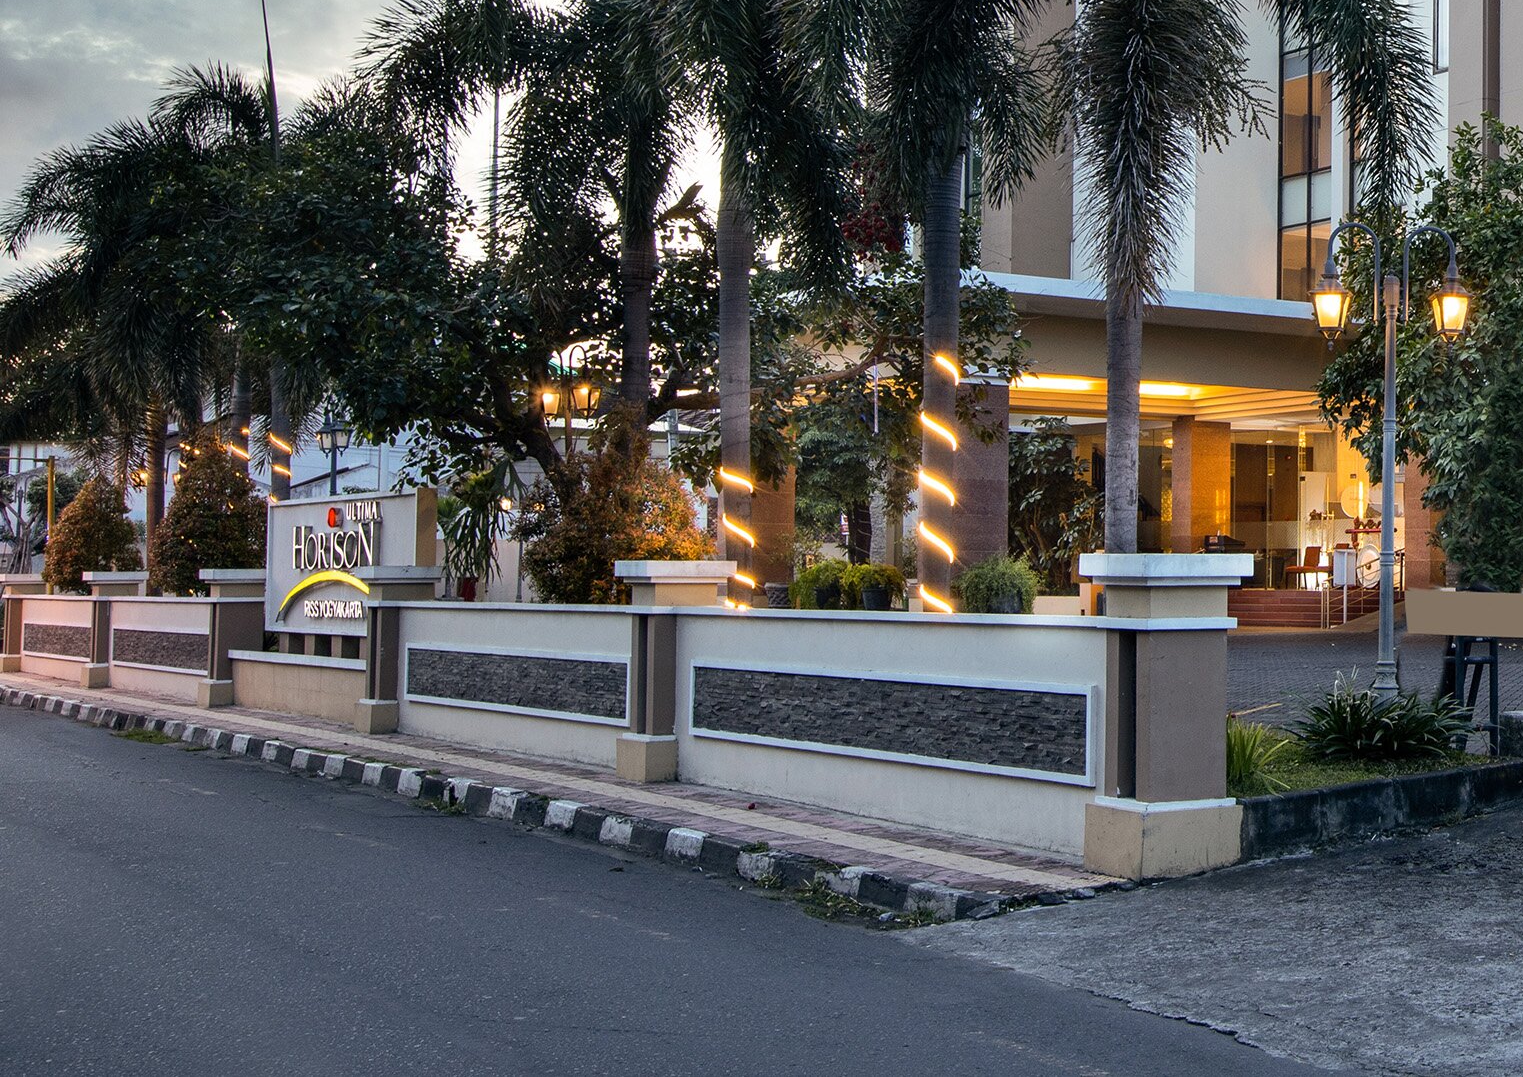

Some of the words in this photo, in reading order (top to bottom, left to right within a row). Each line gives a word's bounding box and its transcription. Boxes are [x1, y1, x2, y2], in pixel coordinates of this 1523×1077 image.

[345, 502, 378, 521] ULTIMA
[292, 521, 375, 571] HORISON
[319, 600, 363, 618] YOGYAKARTA
